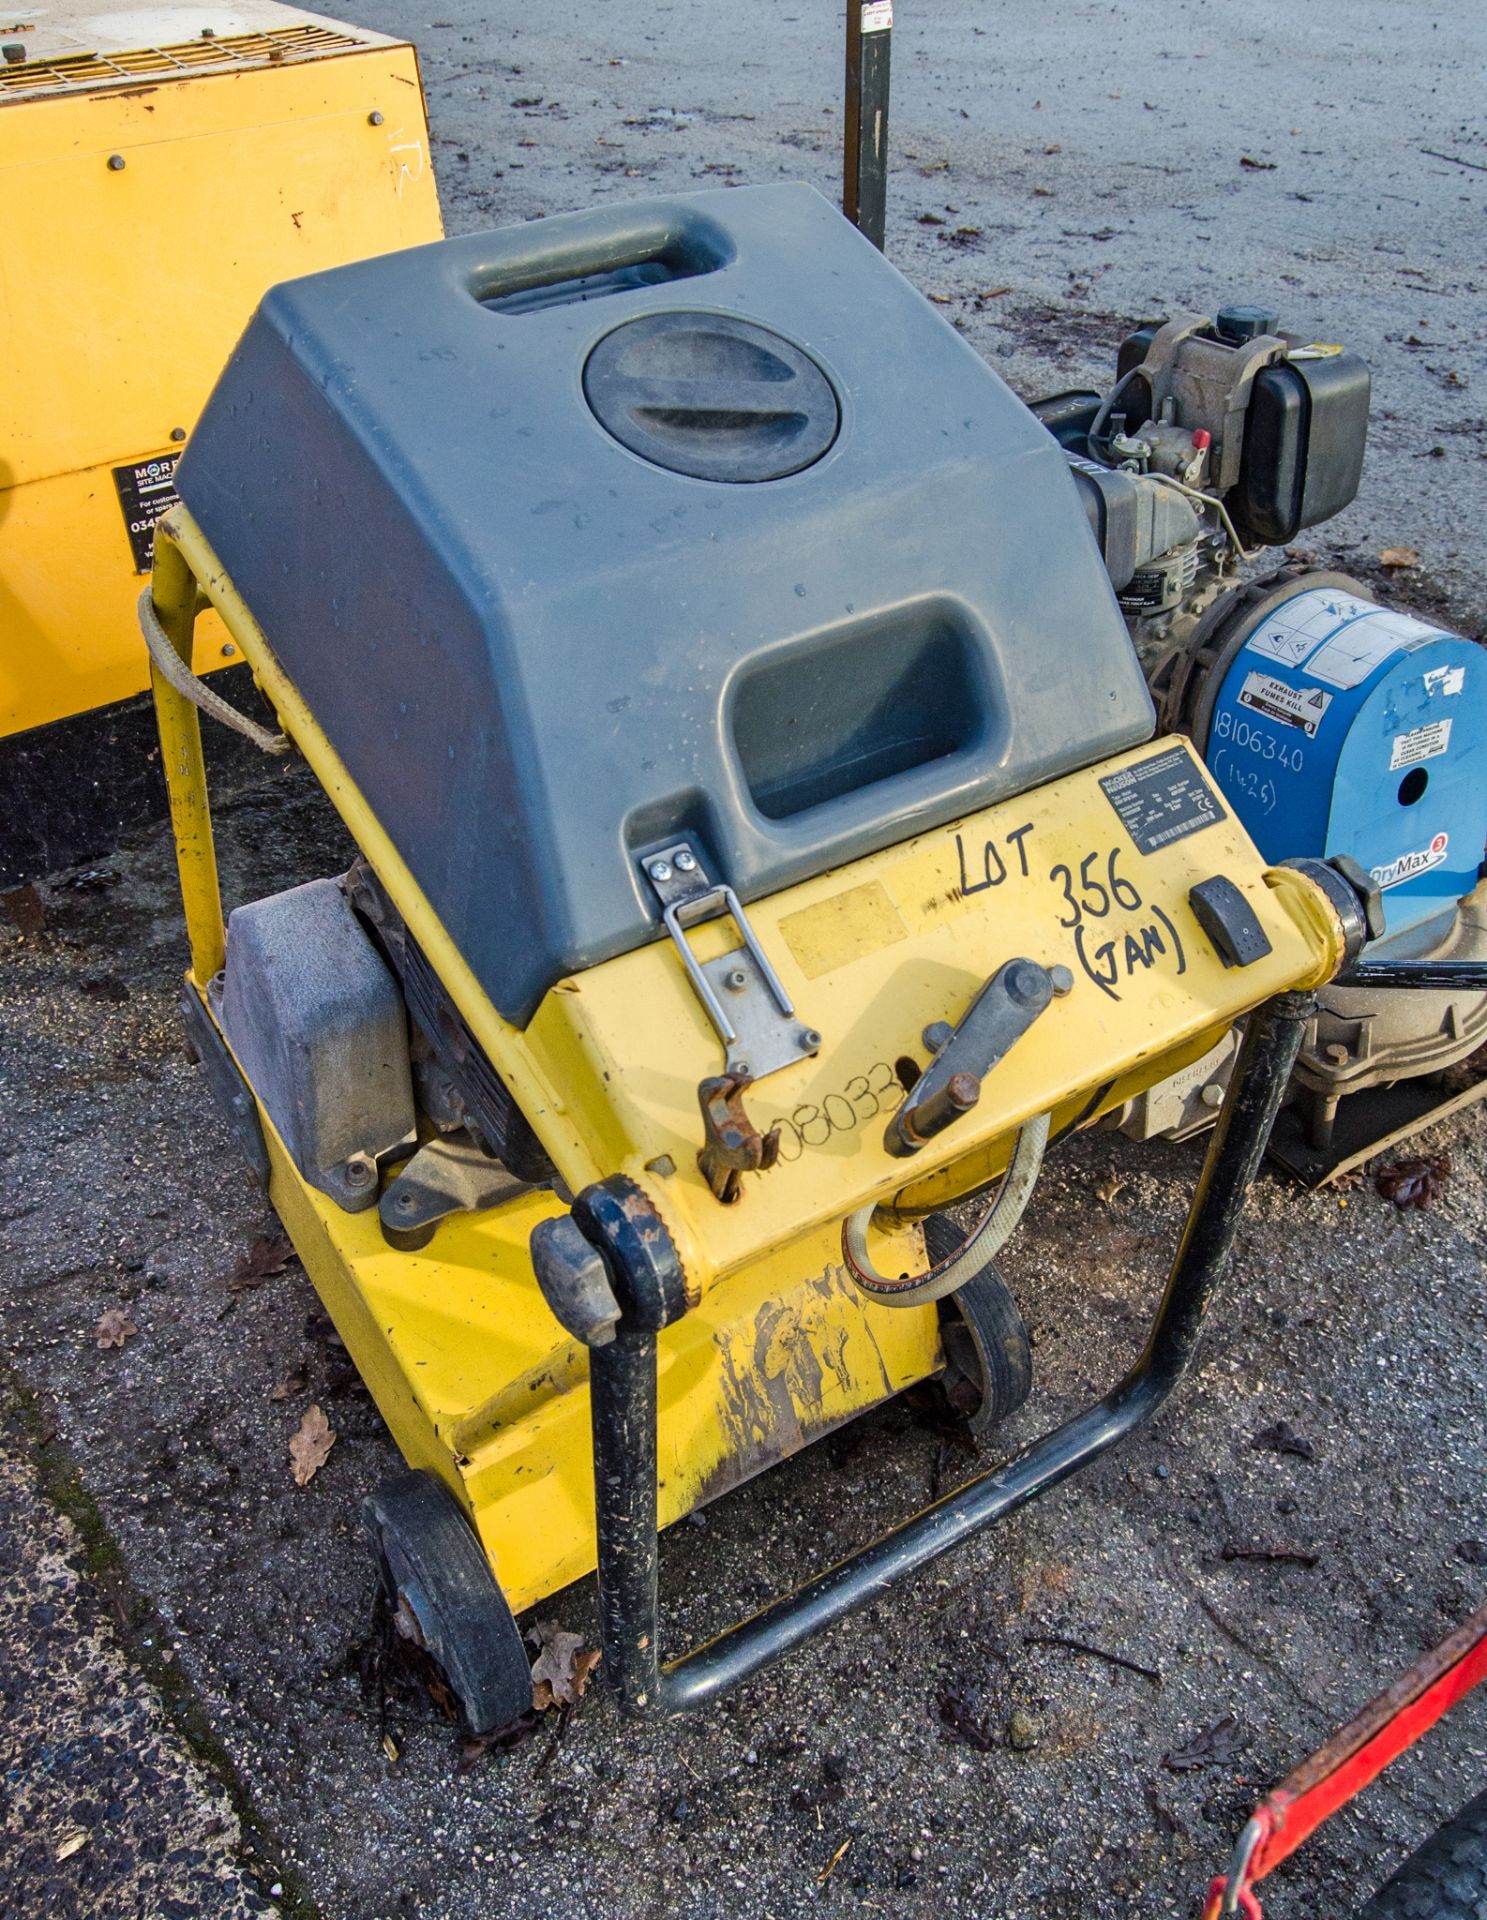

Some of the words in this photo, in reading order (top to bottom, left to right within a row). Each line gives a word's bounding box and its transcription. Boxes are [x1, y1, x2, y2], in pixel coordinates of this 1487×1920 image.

[137, 477, 154, 487] SITE
[139, 501, 152, 509] For
[154, 503, 173, 513] spare
[1260, 687, 1285, 704] FUMES
[1285, 700, 1303, 713] KILL
[1268, 681, 1303, 702] EXHAUST
[1214, 709, 1304, 772] 18106340
[955, 823, 1034, 896] LOT
[1372, 852, 1431, 882] DryMax
[1049, 847, 1143, 928] 356
[1074, 904, 1187, 1002] (JAN)
